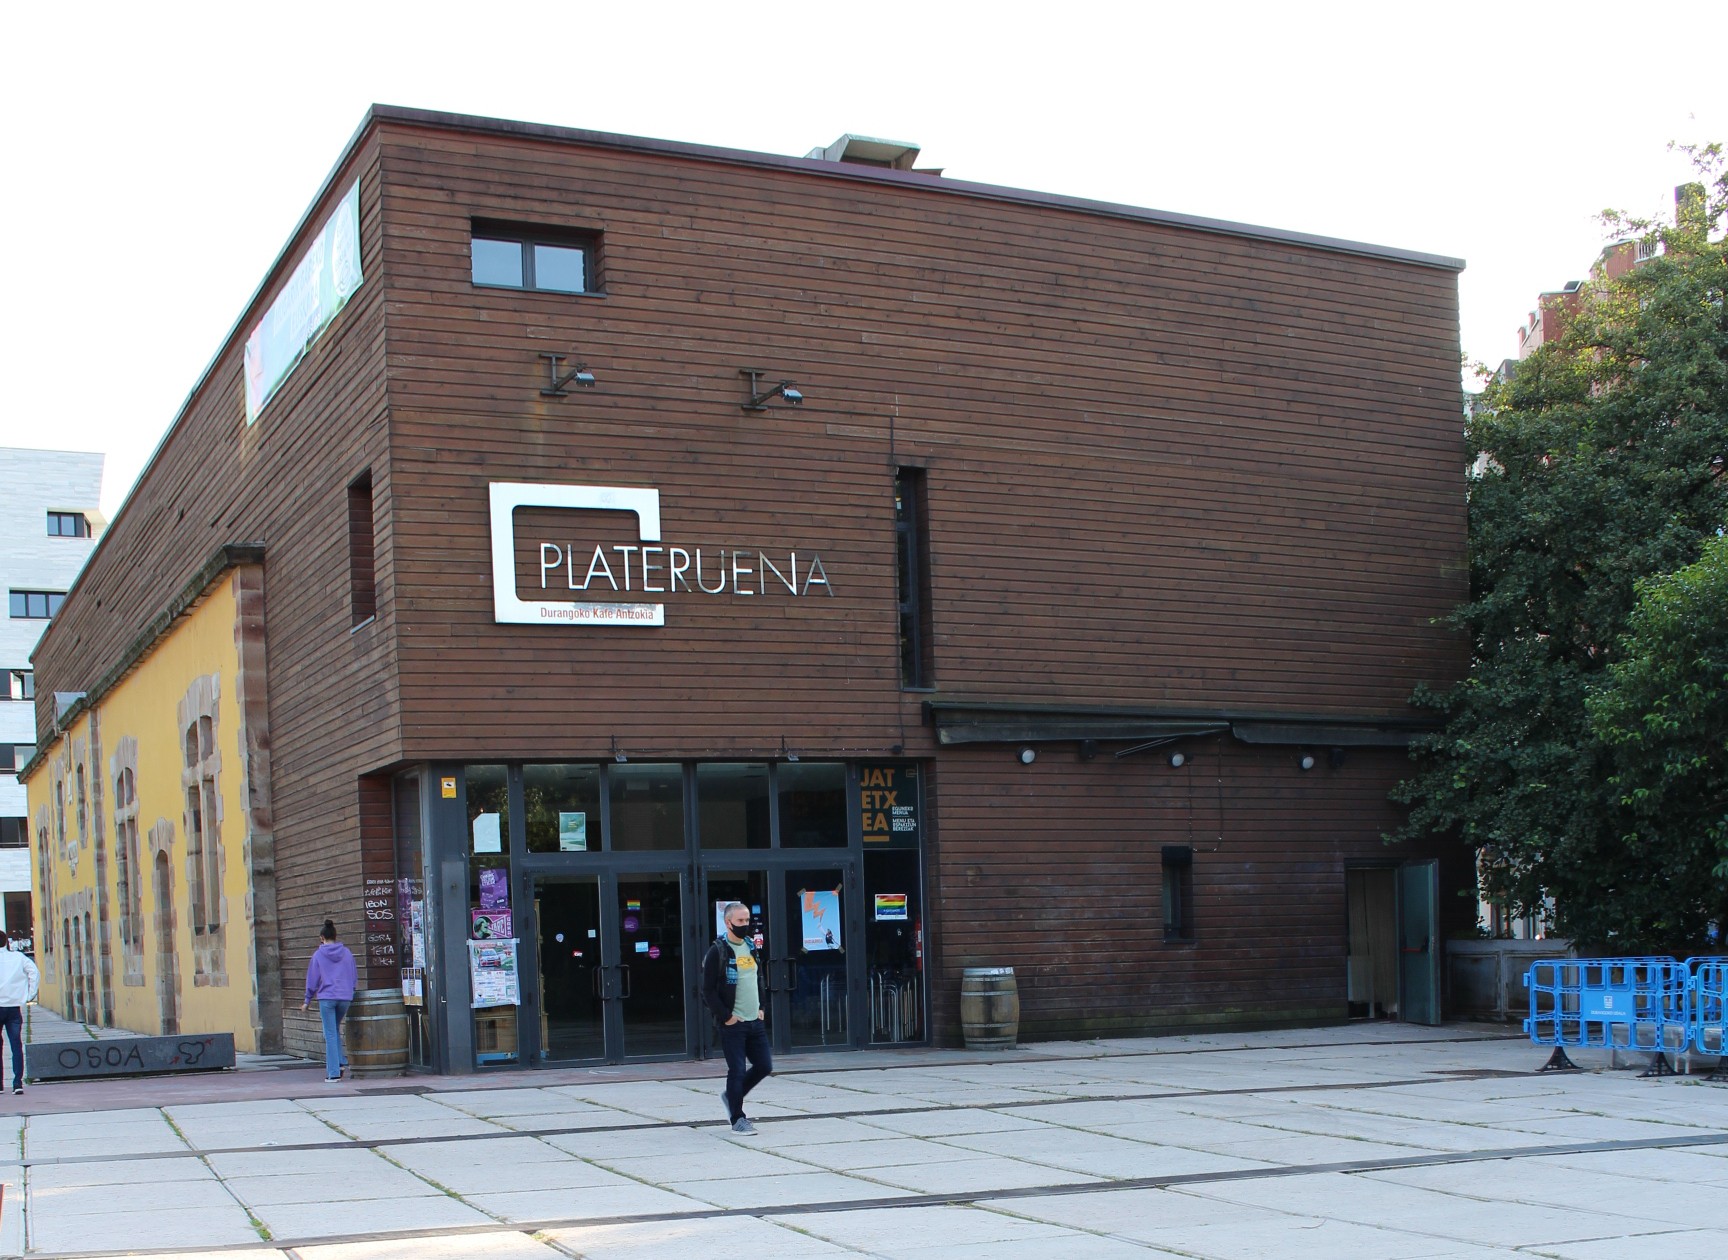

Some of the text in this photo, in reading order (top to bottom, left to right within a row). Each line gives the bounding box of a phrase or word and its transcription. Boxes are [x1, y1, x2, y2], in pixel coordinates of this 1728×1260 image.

[540, 542, 834, 597] PLATERUENA
[540, 607, 654, 621] Durangoko Kafe Antzokia
[860, 768, 895, 787] JAT
[861, 790, 898, 809] ETX
[862, 812, 889, 831] EA
[365, 899, 387, 909] IBON
[58, 1045, 145, 1069] OSOA
